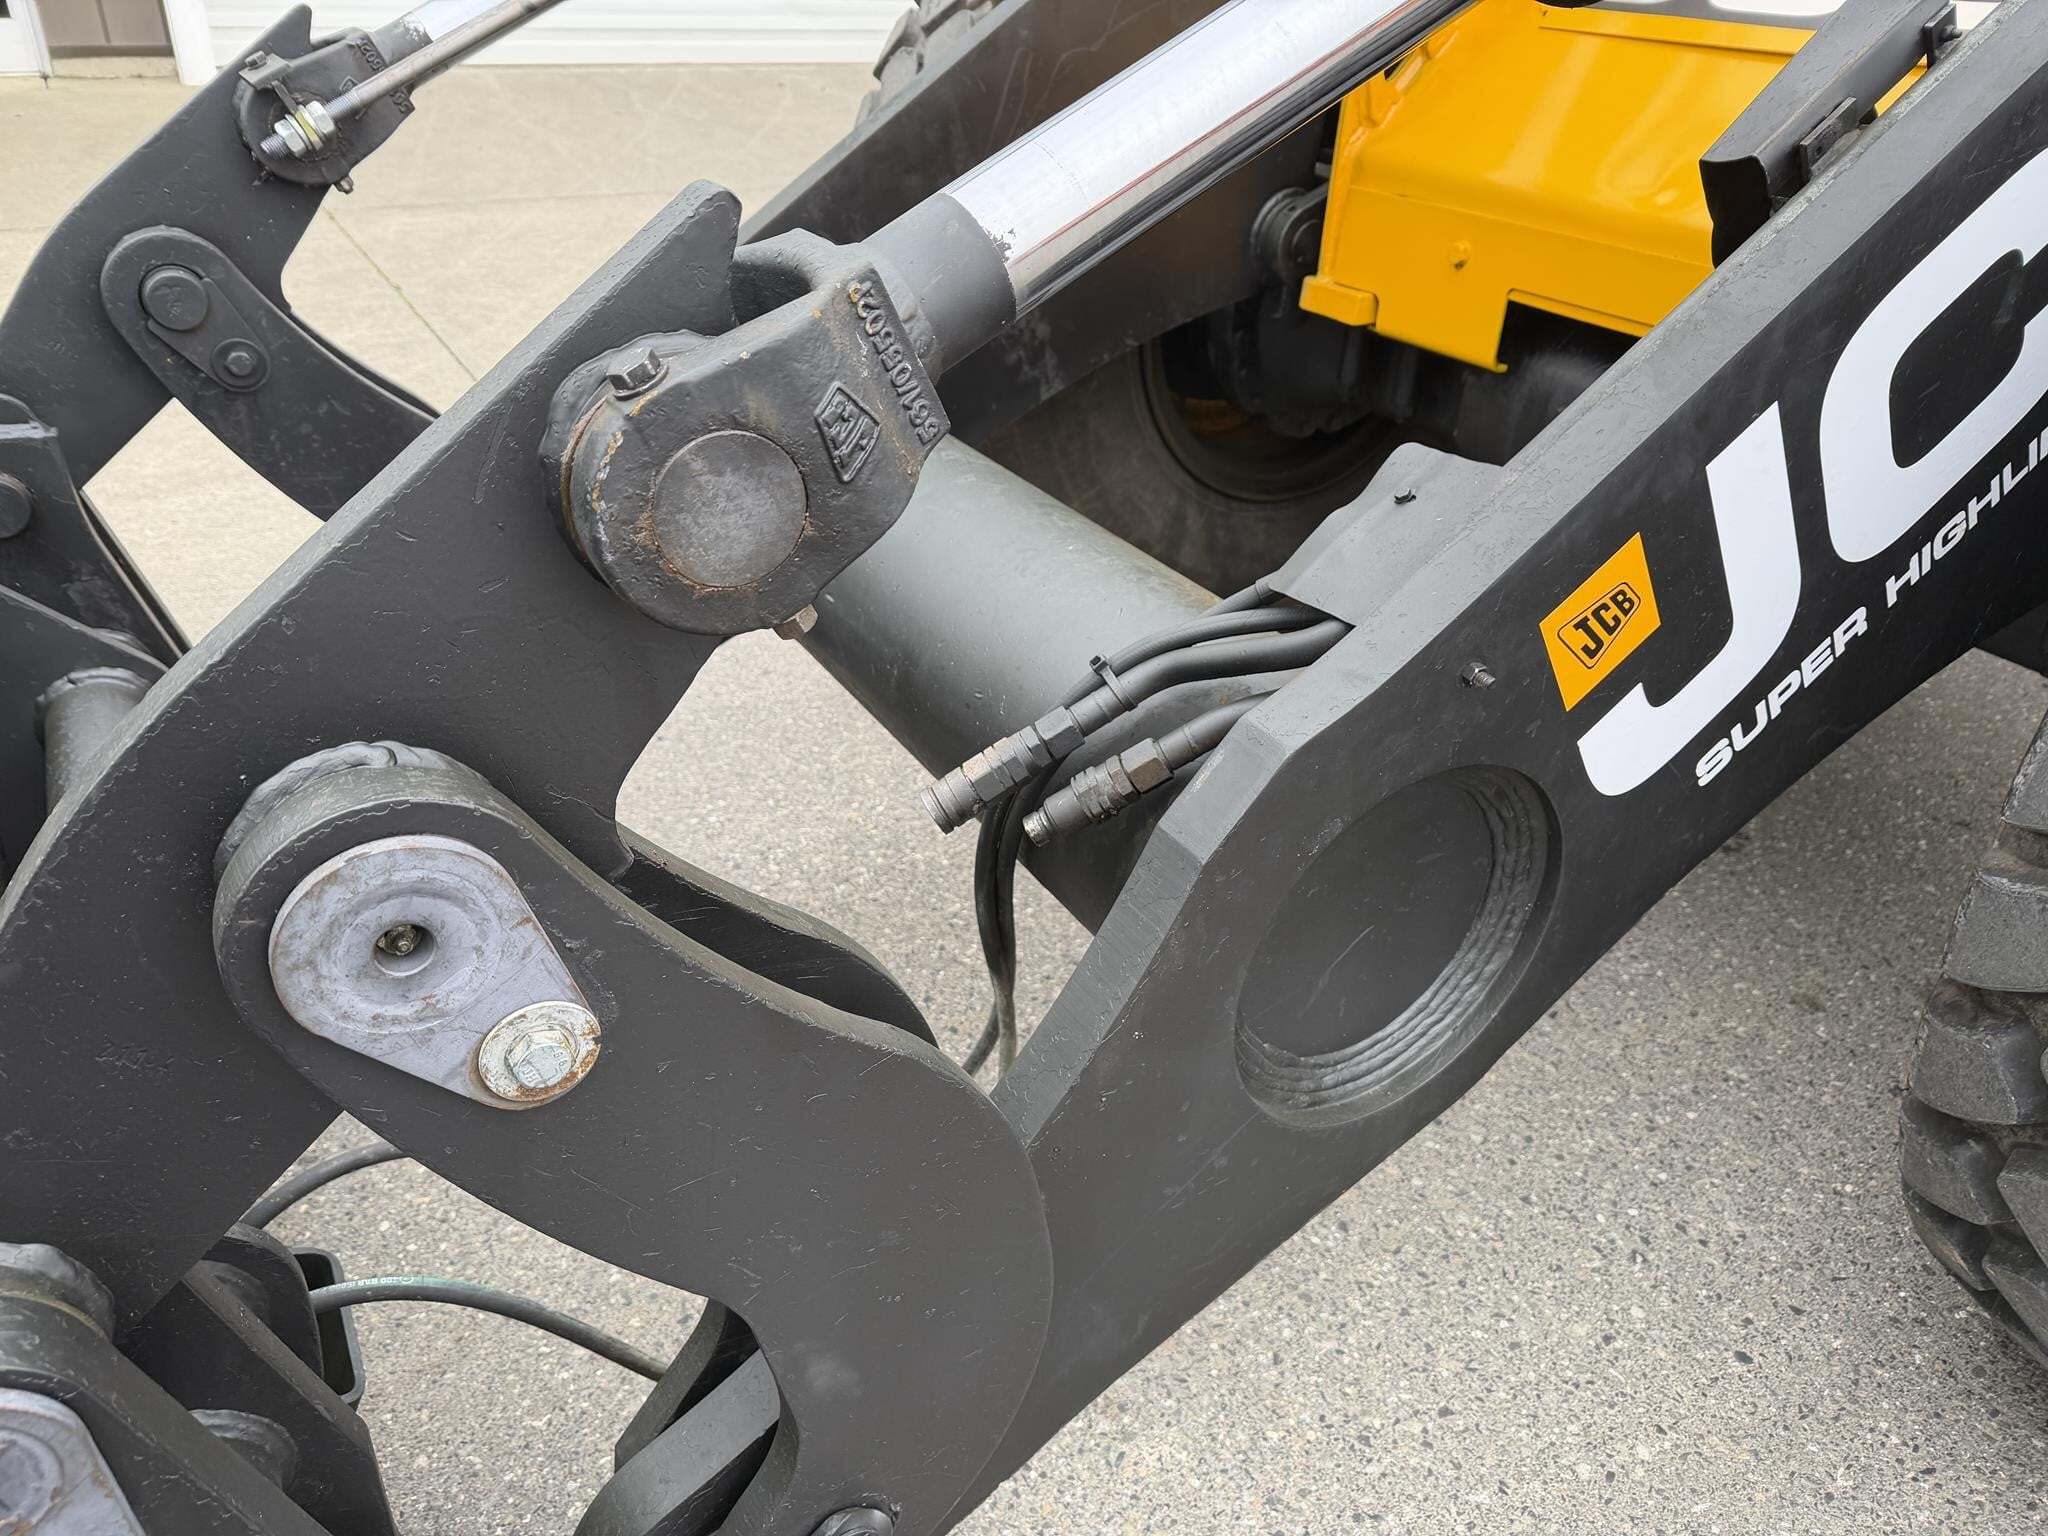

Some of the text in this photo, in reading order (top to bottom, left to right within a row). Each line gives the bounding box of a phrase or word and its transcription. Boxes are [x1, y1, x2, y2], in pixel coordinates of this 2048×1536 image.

[1577, 147, 2048, 796] JC
[1573, 589, 1635, 660] JCB
[1695, 606, 1868, 787] SUPER
